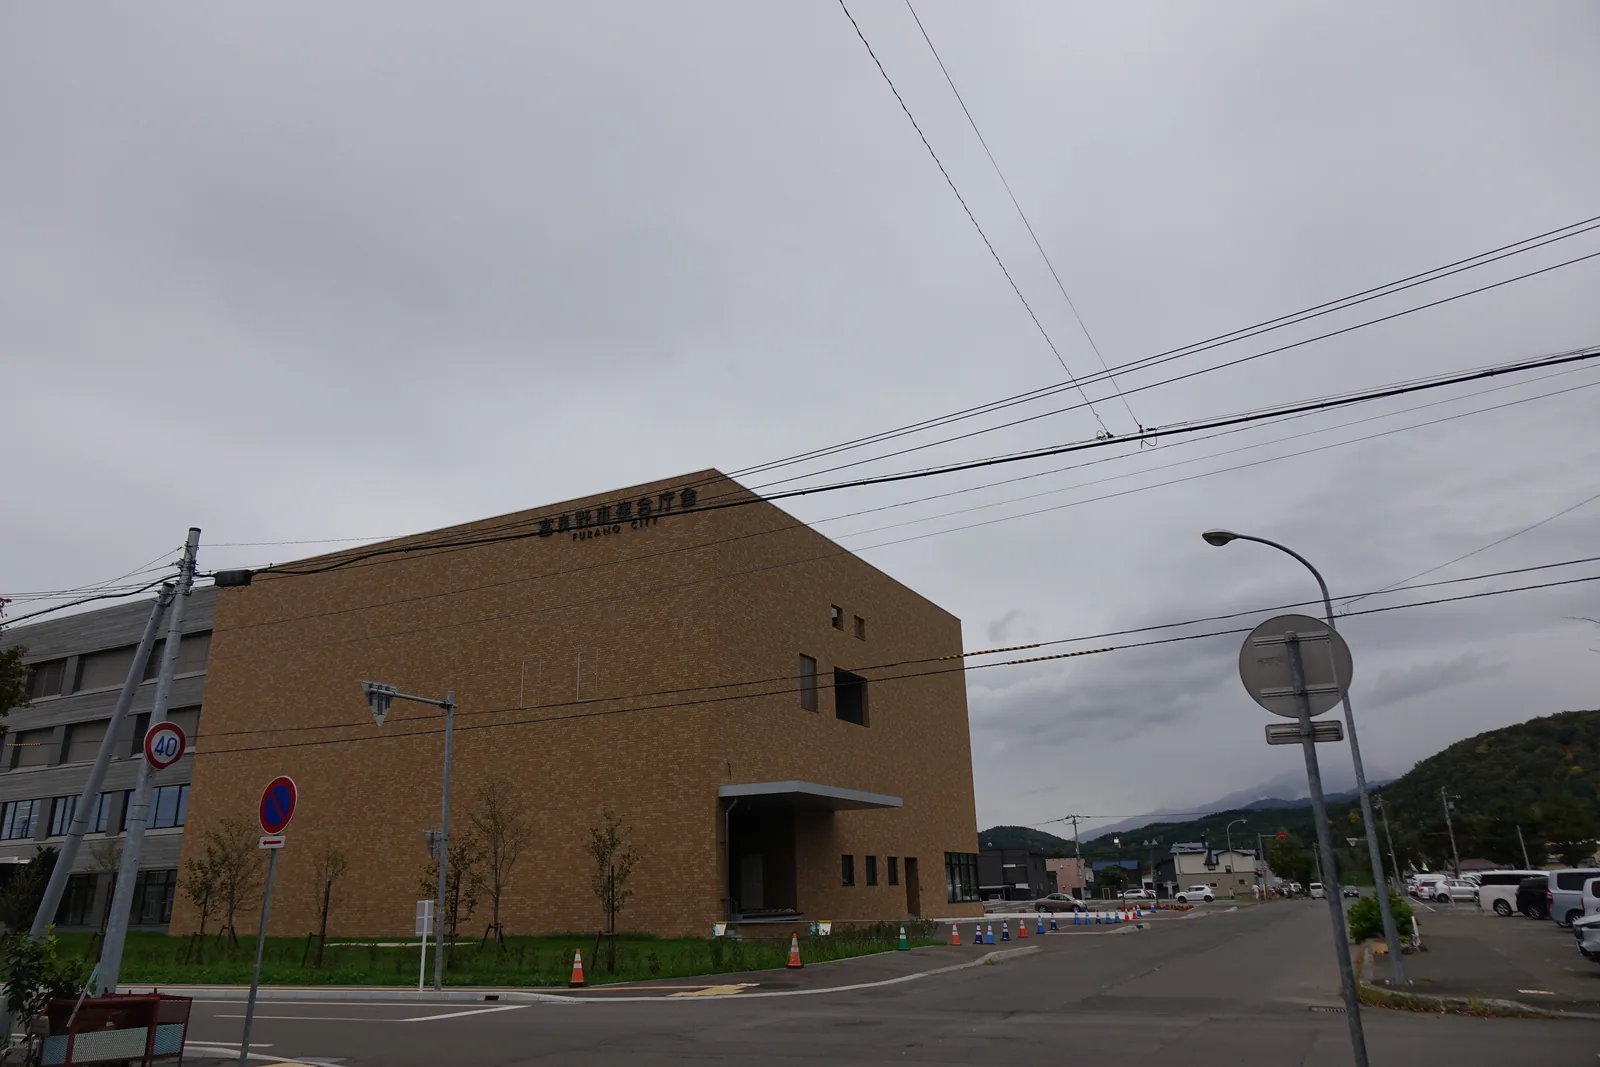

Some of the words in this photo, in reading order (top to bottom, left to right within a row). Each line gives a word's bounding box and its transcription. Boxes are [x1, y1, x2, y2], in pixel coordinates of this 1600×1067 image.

[572, 525, 621, 541] FURANO
[630, 516, 658, 530] CITY
[154, 735, 178, 758] 40
